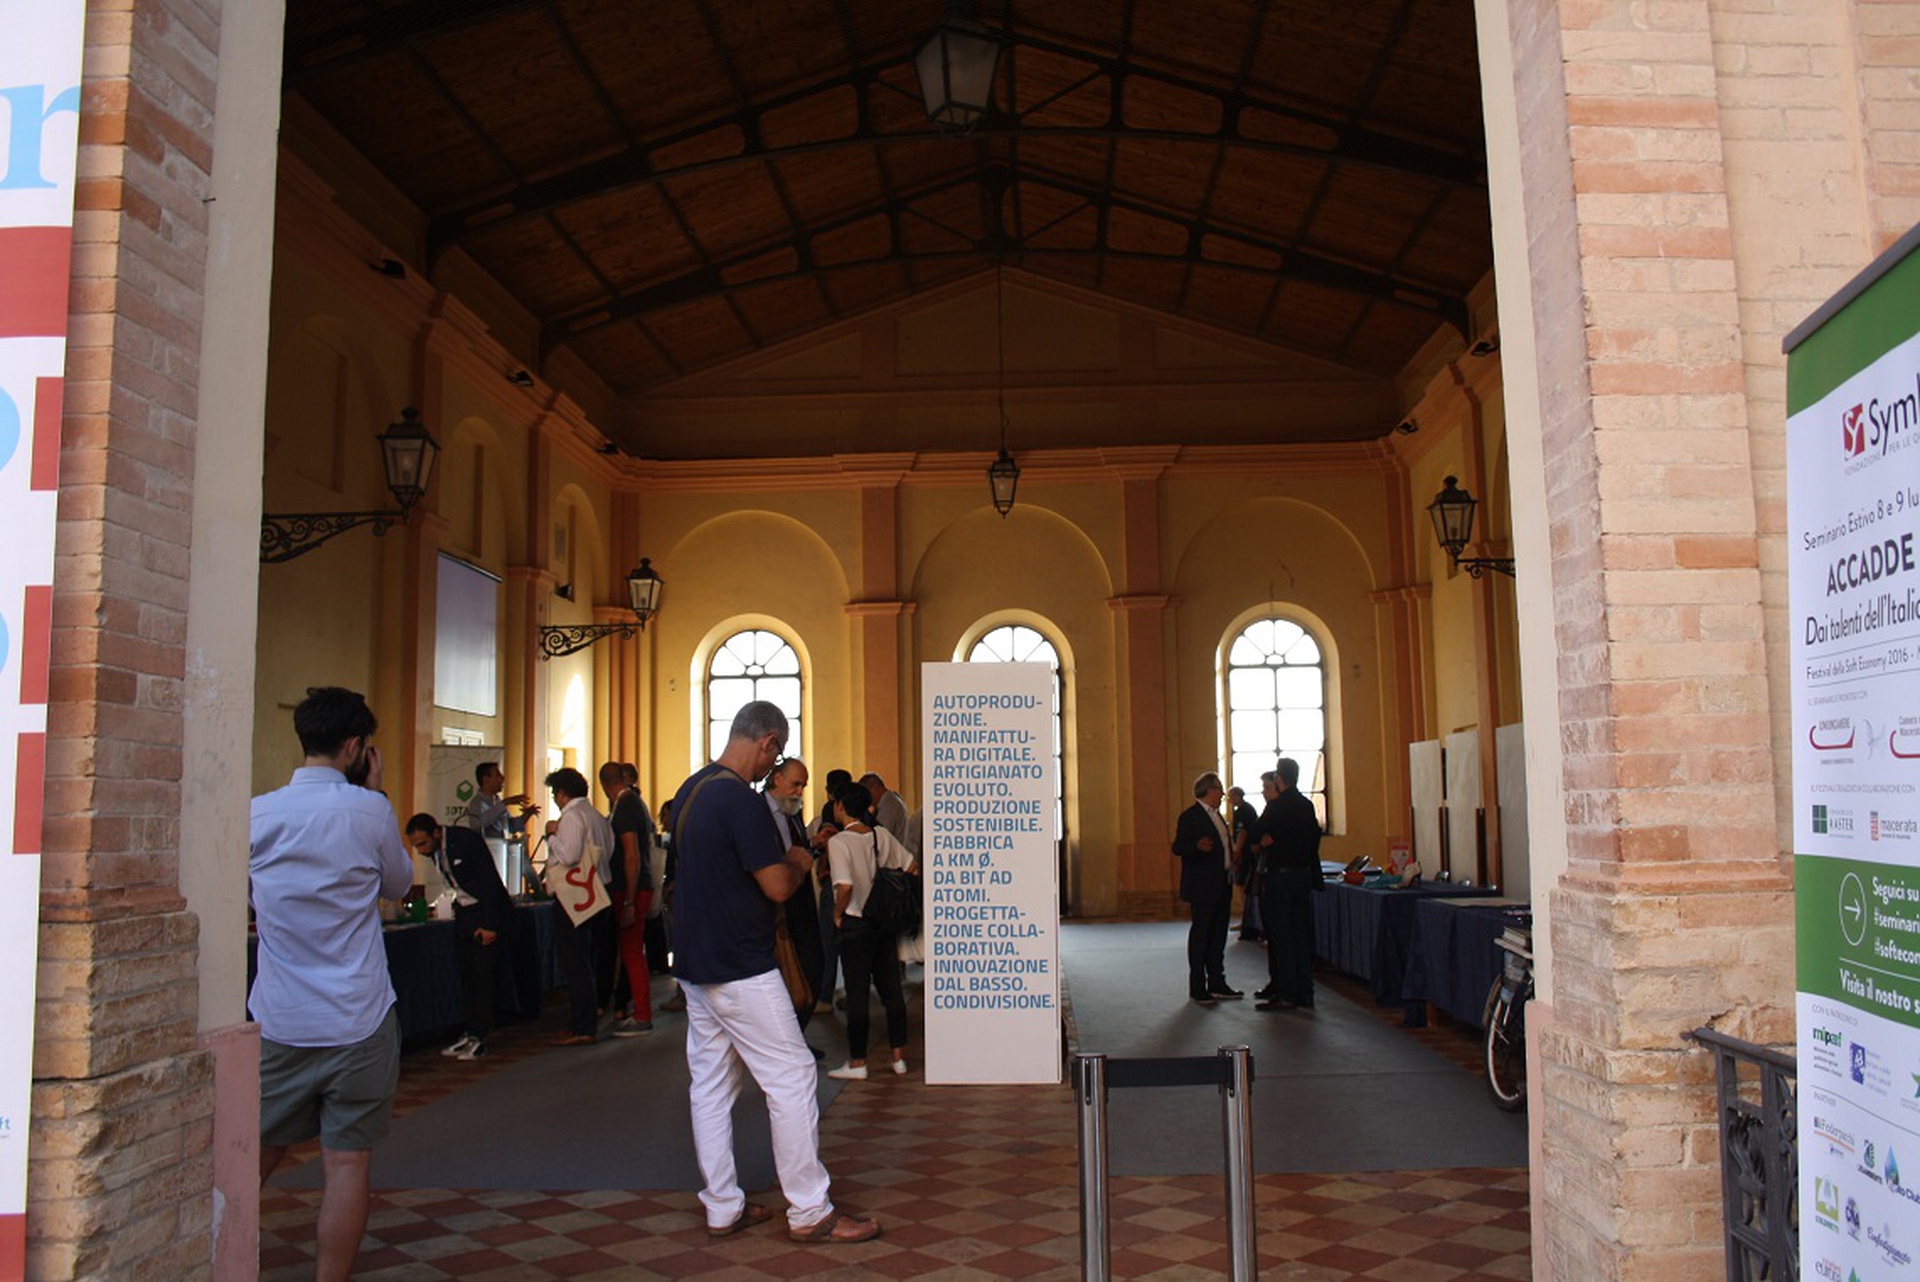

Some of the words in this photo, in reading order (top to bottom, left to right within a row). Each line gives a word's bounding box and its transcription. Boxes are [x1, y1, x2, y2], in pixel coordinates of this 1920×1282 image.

[1804, 519, 1846, 551] Seminario
[1848, 507, 1875, 533] Estivo
[1877, 499, 1883, 520] 8
[1886, 503, 1892, 516] e
[1896, 491, 1903, 512] 9
[1826, 532, 1915, 597] ACCADDE
[1806, 613, 1828, 645] Dai
[1830, 602, 1862, 640] talenti
[1806, 664, 1831, 679] Festival
[1888, 647, 1909, 664] 2016
[933, 695, 1043, 709] AUTOPRODU-
[933, 712, 987, 727] ZIONE.
[933, 730, 1036, 744] MANIFATTU-
[933, 747, 955, 761] RA
[959, 747, 1036, 761] DIGITALE.
[933, 765, 1043, 779] ARTIGIANATO
[933, 783, 1013, 796] EVOLUTO.
[933, 800, 1041, 814] PRODUZIONE
[933, 818, 1043, 832] SOSTENIBILE.
[933, 835, 1014, 849] FABBRICA
[933, 853, 944, 867] A
[948, 853, 974, 867] KM
[933, 871, 956, 885] DA
[960, 871, 985, 885] BIT
[989, 871, 1012, 885] AD
[933, 889, 990, 902] ATOMI.
[1872, 876, 1905, 905] Seguici
[1907, 887, 1920, 902] su
[933, 906, 1026, 920] PROGETTA-
[933, 924, 983, 938] ZIONE
[987, 924, 1045, 938] COLLA-
[934, 942, 1020, 956] BORATIVA.
[934, 959, 1048, 973] INNOVAZIONE
[934, 977, 965, 991] DAL
[969, 977, 1027, 991] BASSO.
[1839, 968, 1865, 998] Visita
[1866, 977, 1873, 1000] il
[1875, 988, 1911, 1012] nostro
[934, 994, 1055, 1009] CONDIVISIONE.
